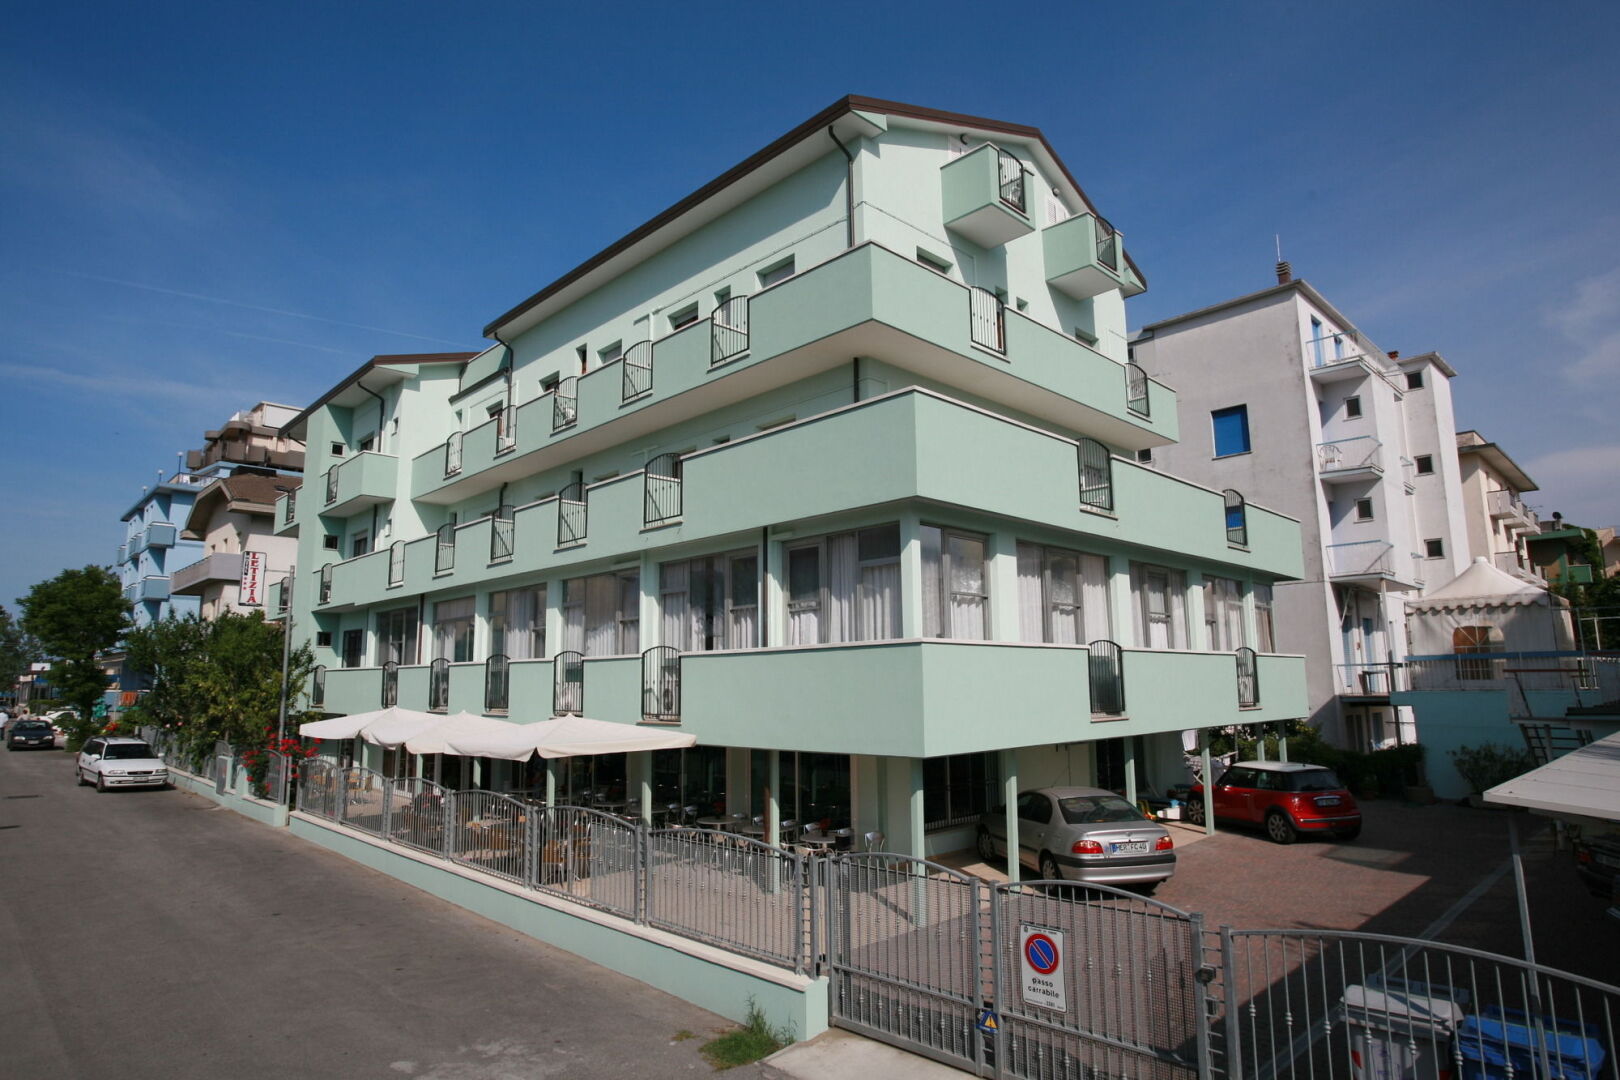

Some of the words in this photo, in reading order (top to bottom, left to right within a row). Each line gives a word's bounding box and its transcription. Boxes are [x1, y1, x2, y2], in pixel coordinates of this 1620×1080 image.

[247, 552, 259, 603] LETIZIA
[1032, 977, 1053, 988] passo
[1028, 985, 1060, 999] carrabile
